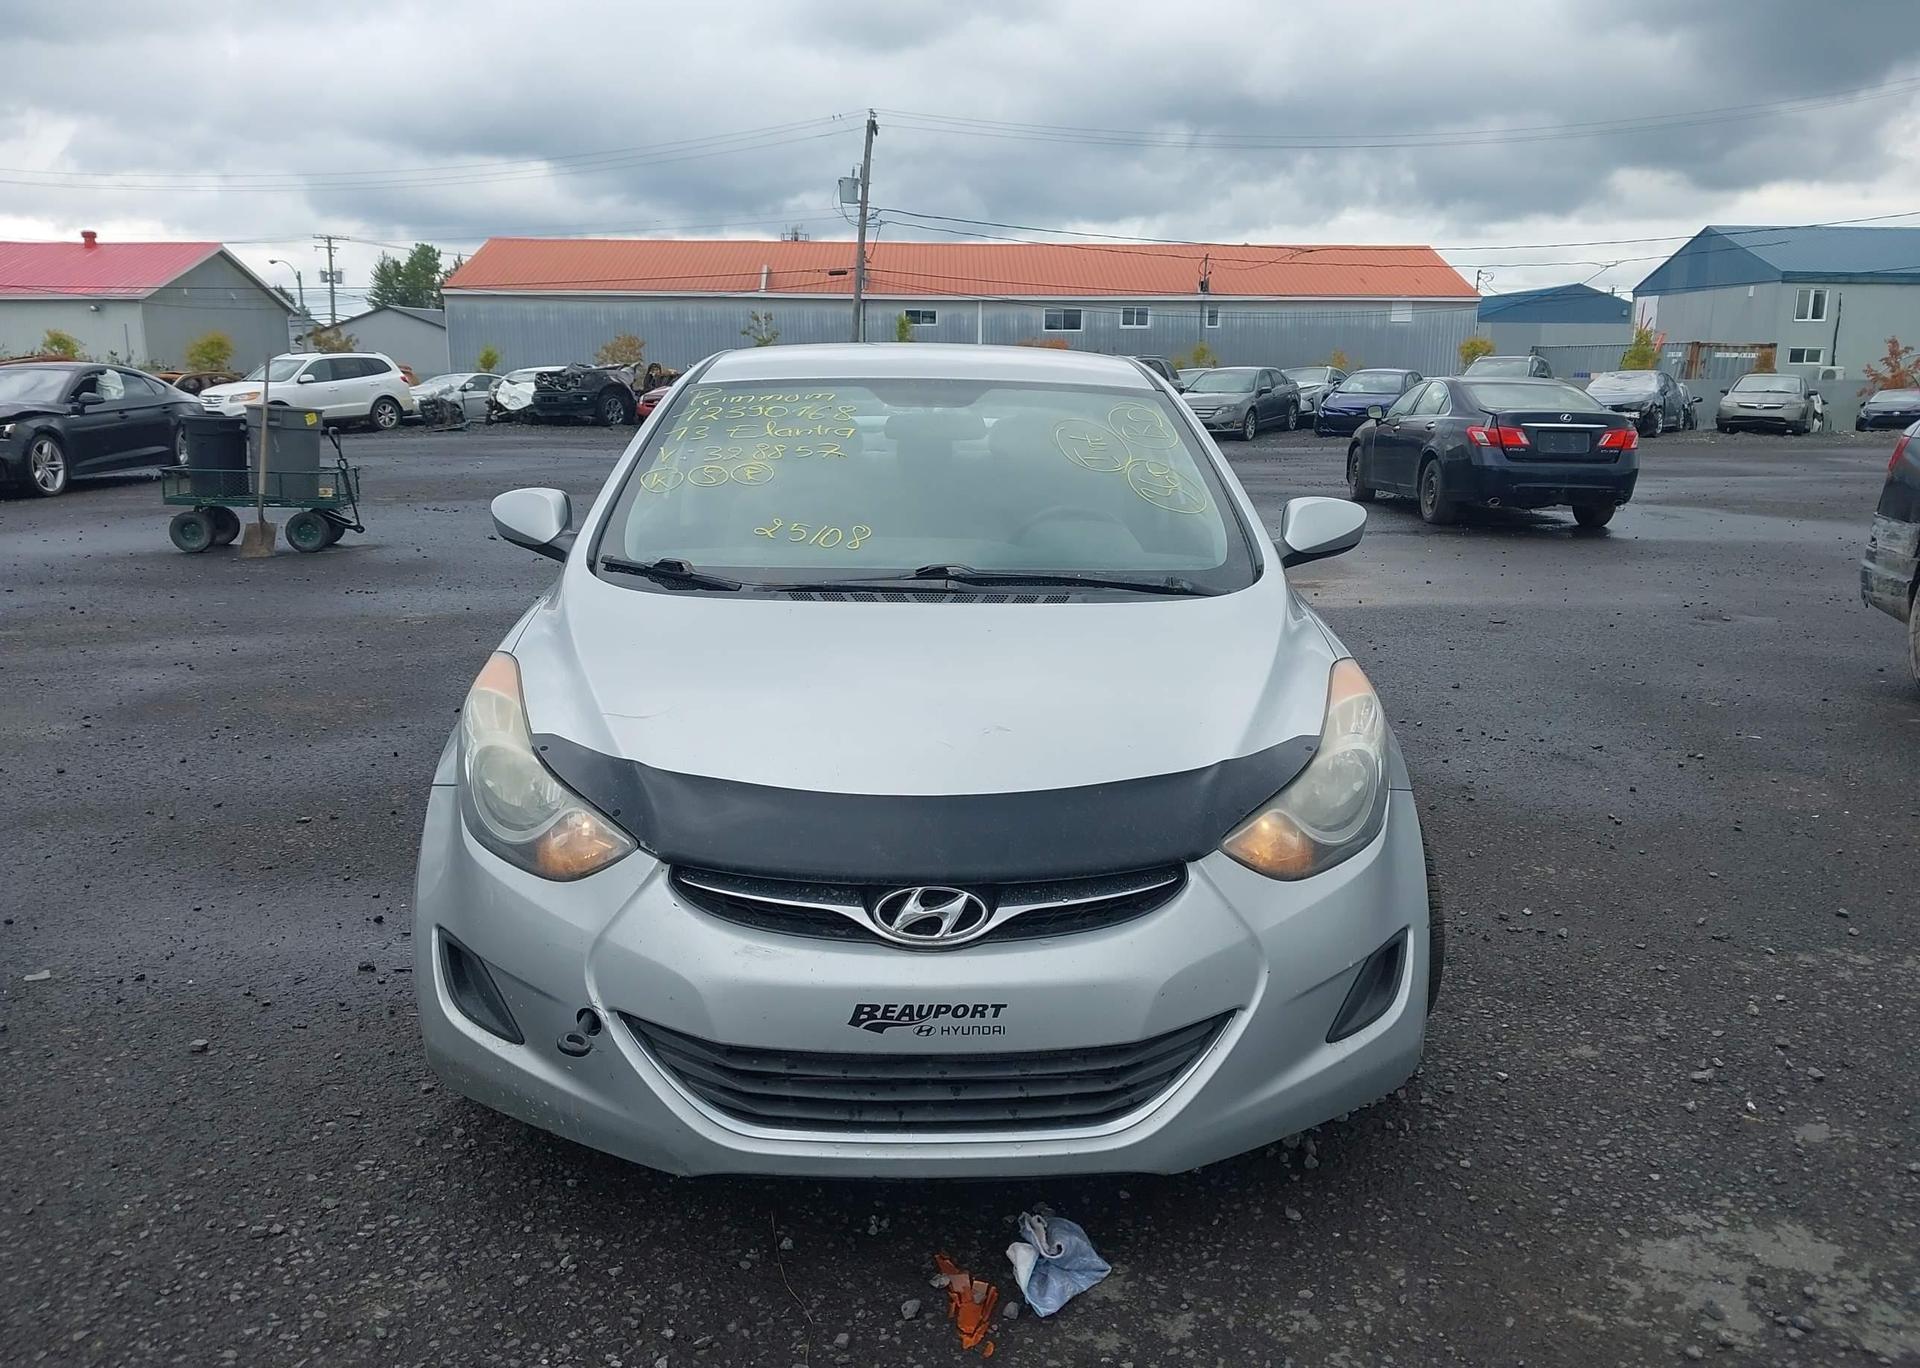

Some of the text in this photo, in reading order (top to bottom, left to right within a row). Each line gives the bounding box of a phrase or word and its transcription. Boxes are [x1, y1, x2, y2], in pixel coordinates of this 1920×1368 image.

[727, 420, 856, 438] Elantra
[848, 1004, 1008, 1029] BEAUPORT
[941, 1025, 1006, 1036] HYUNDAI
